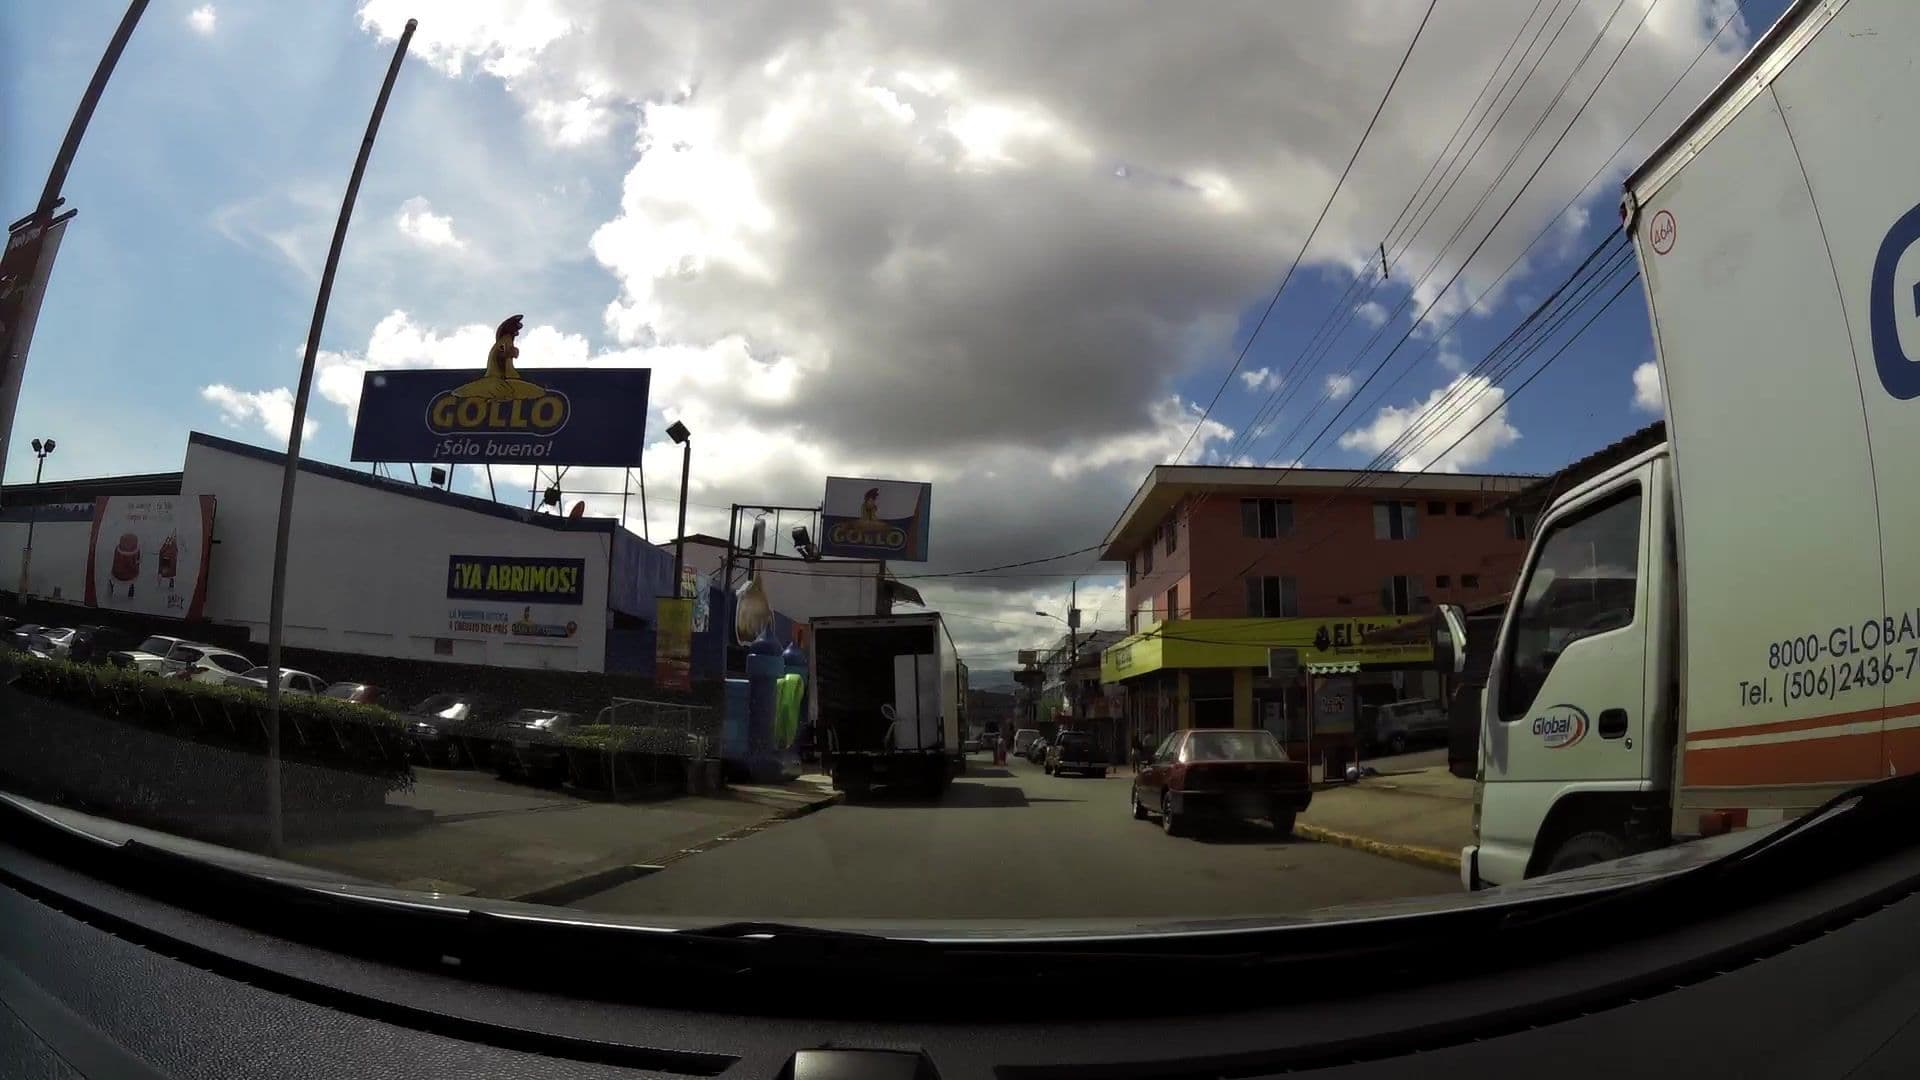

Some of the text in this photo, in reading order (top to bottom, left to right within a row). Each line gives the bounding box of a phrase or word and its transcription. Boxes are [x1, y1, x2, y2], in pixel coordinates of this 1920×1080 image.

[433, 397, 563, 428] GOLLO
[434, 438, 553, 459] ¡Sólo bueno!
[832, 527, 904, 546] GOLLO
[453, 563, 577, 593] ¡YA ABRIMOS!
[1740, 647, 1920, 707] Tel. (506)2436-7
[1533, 713, 1571, 735] Global
